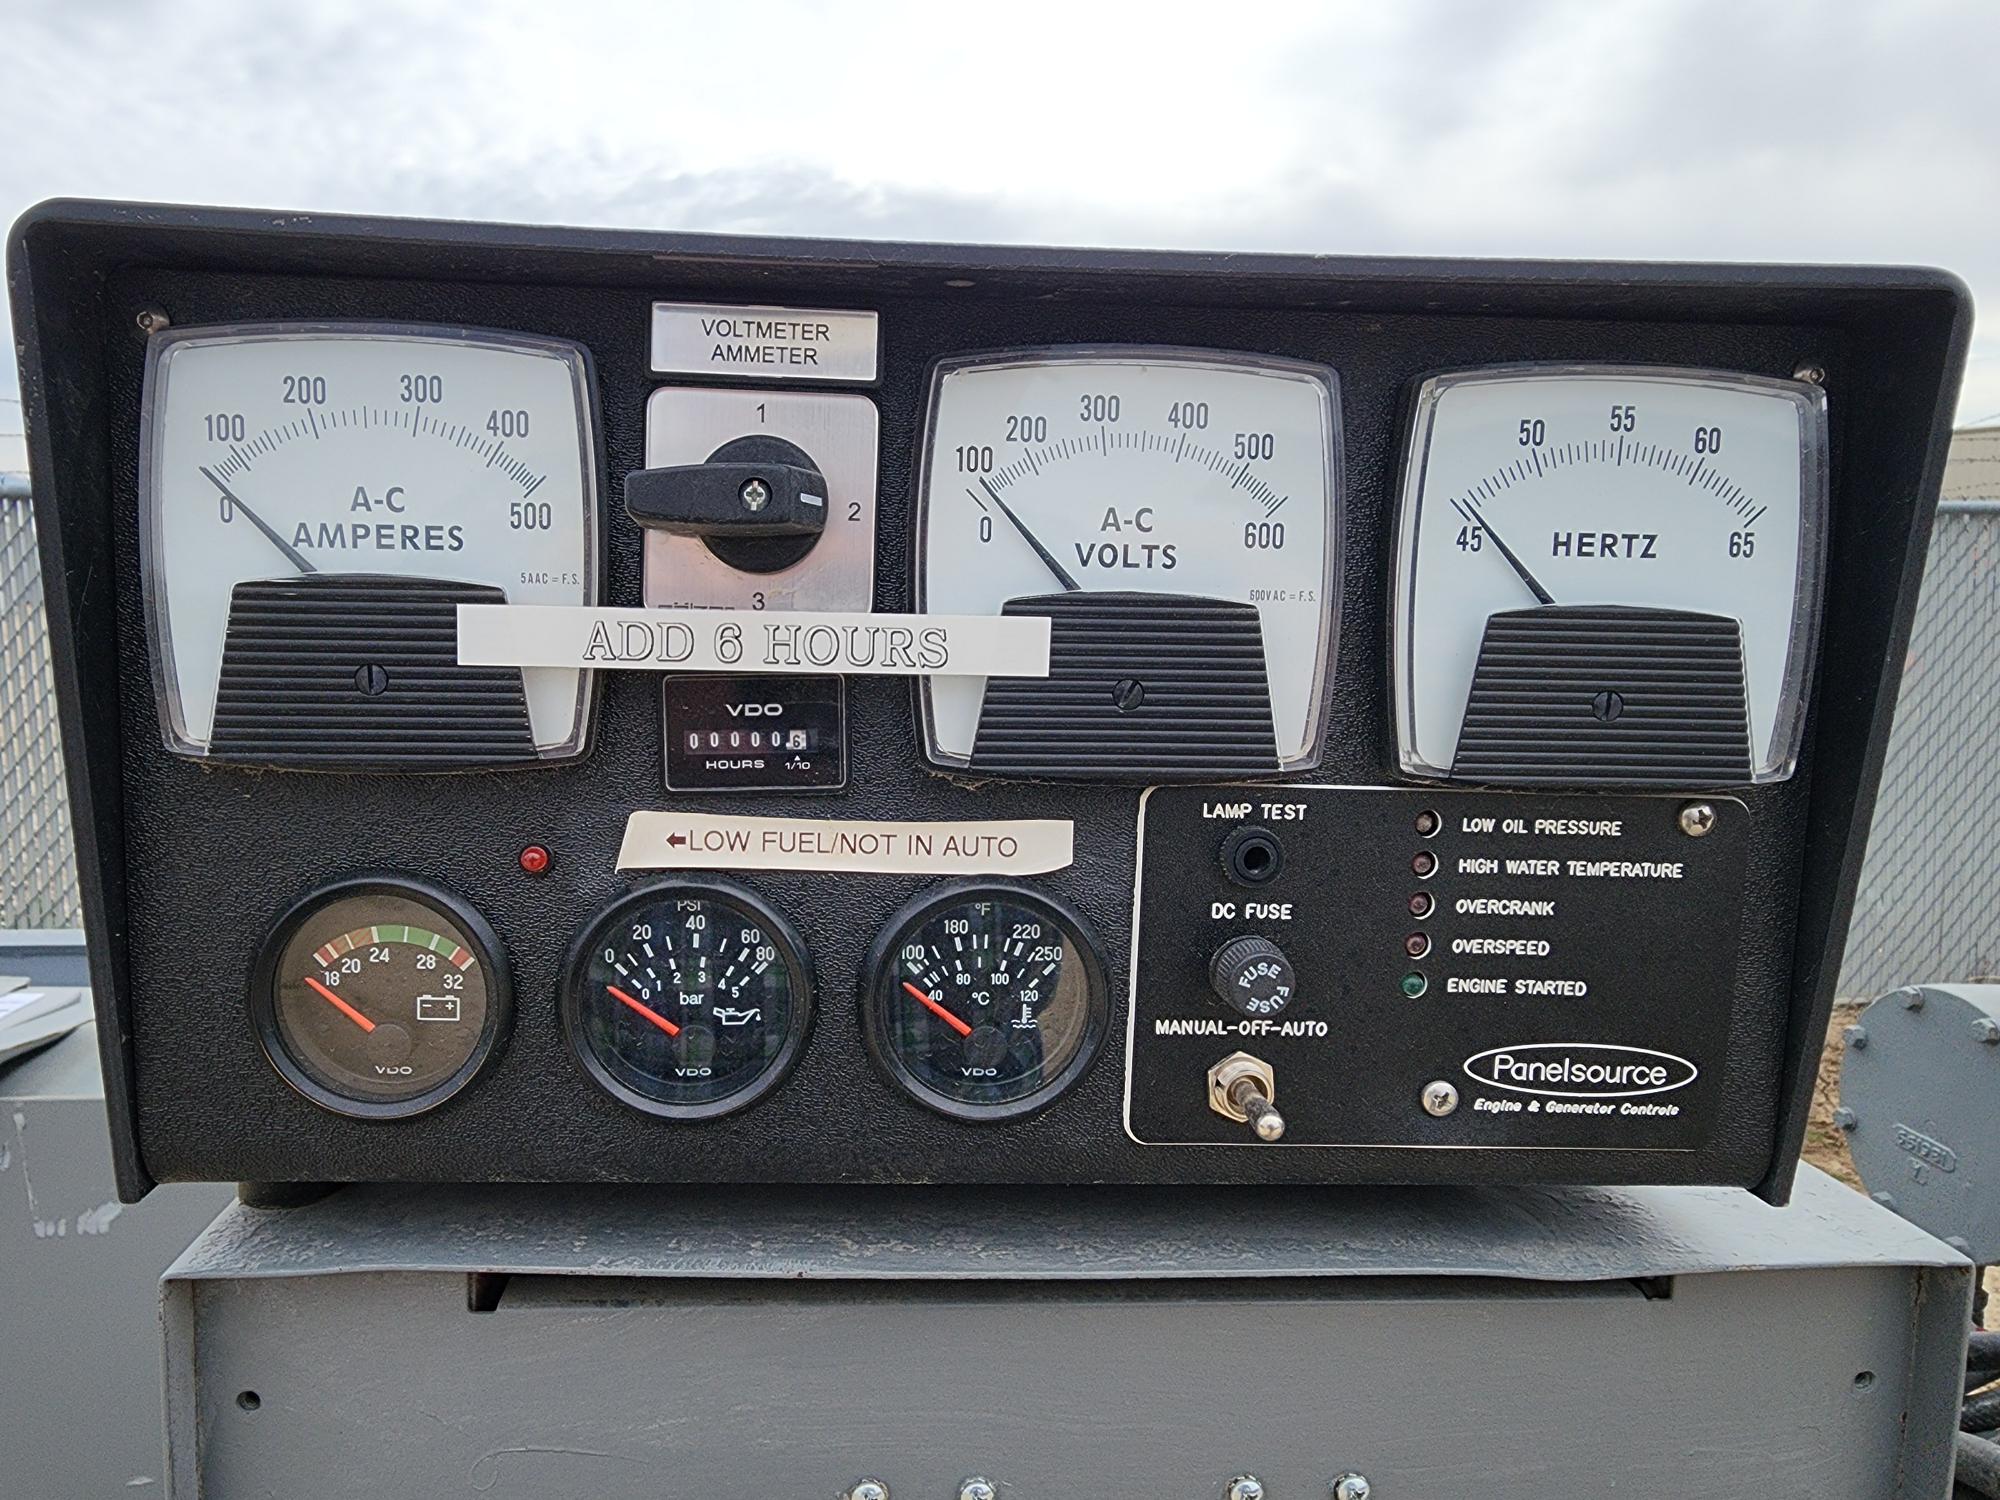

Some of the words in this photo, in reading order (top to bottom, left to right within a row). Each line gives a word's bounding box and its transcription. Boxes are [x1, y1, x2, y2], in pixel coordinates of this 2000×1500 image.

[701, 318, 831, 343] VOLTMETER
[711, 343, 819, 366] AMMETER
[282, 376, 326, 404] 200
[400, 375, 442, 404] 300
[757, 403, 767, 423] 1
[1079, 395, 1120, 422] 300
[1167, 402, 1209, 429] 400
[486, 410, 529, 438] 400
[1609, 405, 1636, 432] 55
[204, 414, 245, 442] 100
[1005, 416, 1047, 443] 200
[1518, 419, 1546, 446] 50
[1234, 433, 1274, 460] 500
[1694, 427, 1721, 454] 60
[956, 446, 993, 473] 100
[350, 486, 406, 513] A-C
[219, 497, 234, 524] 0
[510, 503, 552, 530] 500
[848, 502, 861, 522] 2
[1100, 507, 1154, 532] A-C
[292, 523, 464, 551] AMPERES
[979, 516, 992, 543] 0
[1244, 522, 1285, 549] 600
[1456, 526, 1483, 552] 45
[1552, 532, 1659, 559] HERTZ
[1729, 532, 1755, 558] 65
[1074, 542, 1178, 570] VOLTS
[562, 573, 580, 585] F.S.
[752, 593, 765, 611] 3
[583, 620, 695, 662] ADD
[713, 622, 743, 664] 6
[763, 624, 950, 669] HOURS
[725, 703, 783, 717] VDO
[706, 759, 765, 769] HOURS
[784, 761, 811, 770] 1/10
[1203, 803, 1252, 819] LAMP
[1261, 803, 1308, 821] TEST
[1462, 818, 1496, 833] LOW
[1502, 819, 1528, 834] OIL
[1535, 820, 1622, 836] PRESSURE
[688, 828, 754, 853] LOW
[761, 830, 900, 857] FUEL/NOT
[907, 834, 936, 856] IN
[942, 835, 1019, 859] AUTO
[1458, 859, 1499, 874] HIGH
[1506, 860, 1559, 875] WATER
[1567, 861, 1684, 878] TEMPERATURE
[677, 900, 701, 912] PSI
[1211, 903, 1236, 919] DC
[1245, 903, 1293, 920] FUSE
[1455, 899, 1555, 916] OVERCRANK
[632, 924, 652, 939] 20
[685, 915, 705, 930] 40
[944, 920, 969, 934] 180
[1012, 924, 1041, 939] 220
[741, 929, 760, 944] 60
[369, 947, 390, 963] 24
[604, 948, 615, 963] 0
[756, 946, 775, 961] 80
[1035, 947, 1062, 961] 250
[1452, 939, 1550, 956] OVERSPEED
[341, 958, 361, 973] 20
[416, 954, 436, 970] 28
[324, 971, 340, 986] 18
[443, 974, 463, 990] 32
[673, 972, 681, 984] 2
[698, 972, 706, 983] 3
[718, 978, 726, 990] 4
[956, 973, 971, 985] 80
[991, 973, 1010, 985] 100
[1238, 962, 1282, 989] FUSE
[641, 988, 650, 1000] 0
[656, 980, 661, 991] 1
[732, 986, 739, 998] 5
[1447, 978, 1508, 993] ENGINE
[1515, 980, 1587, 996] STARTED
[680, 992, 704, 1005] bar
[1020, 990, 1038, 1002] 120
[1246, 985, 1290, 1013] FUSE
[1155, 1019, 1328, 1037] MANUAL-OFF-AUTO
[375, 1066, 413, 1075] VDO
[675, 1067, 712, 1077] VDO
[961, 1067, 997, 1077] VDO
[1493, 1055, 1668, 1085] Panelsource
[1474, 1098, 1522, 1114] Engine
[1528, 1101, 1539, 1112] &
[1545, 1101, 1616, 1115] Generator
[1620, 1103, 1680, 1116] Controls
